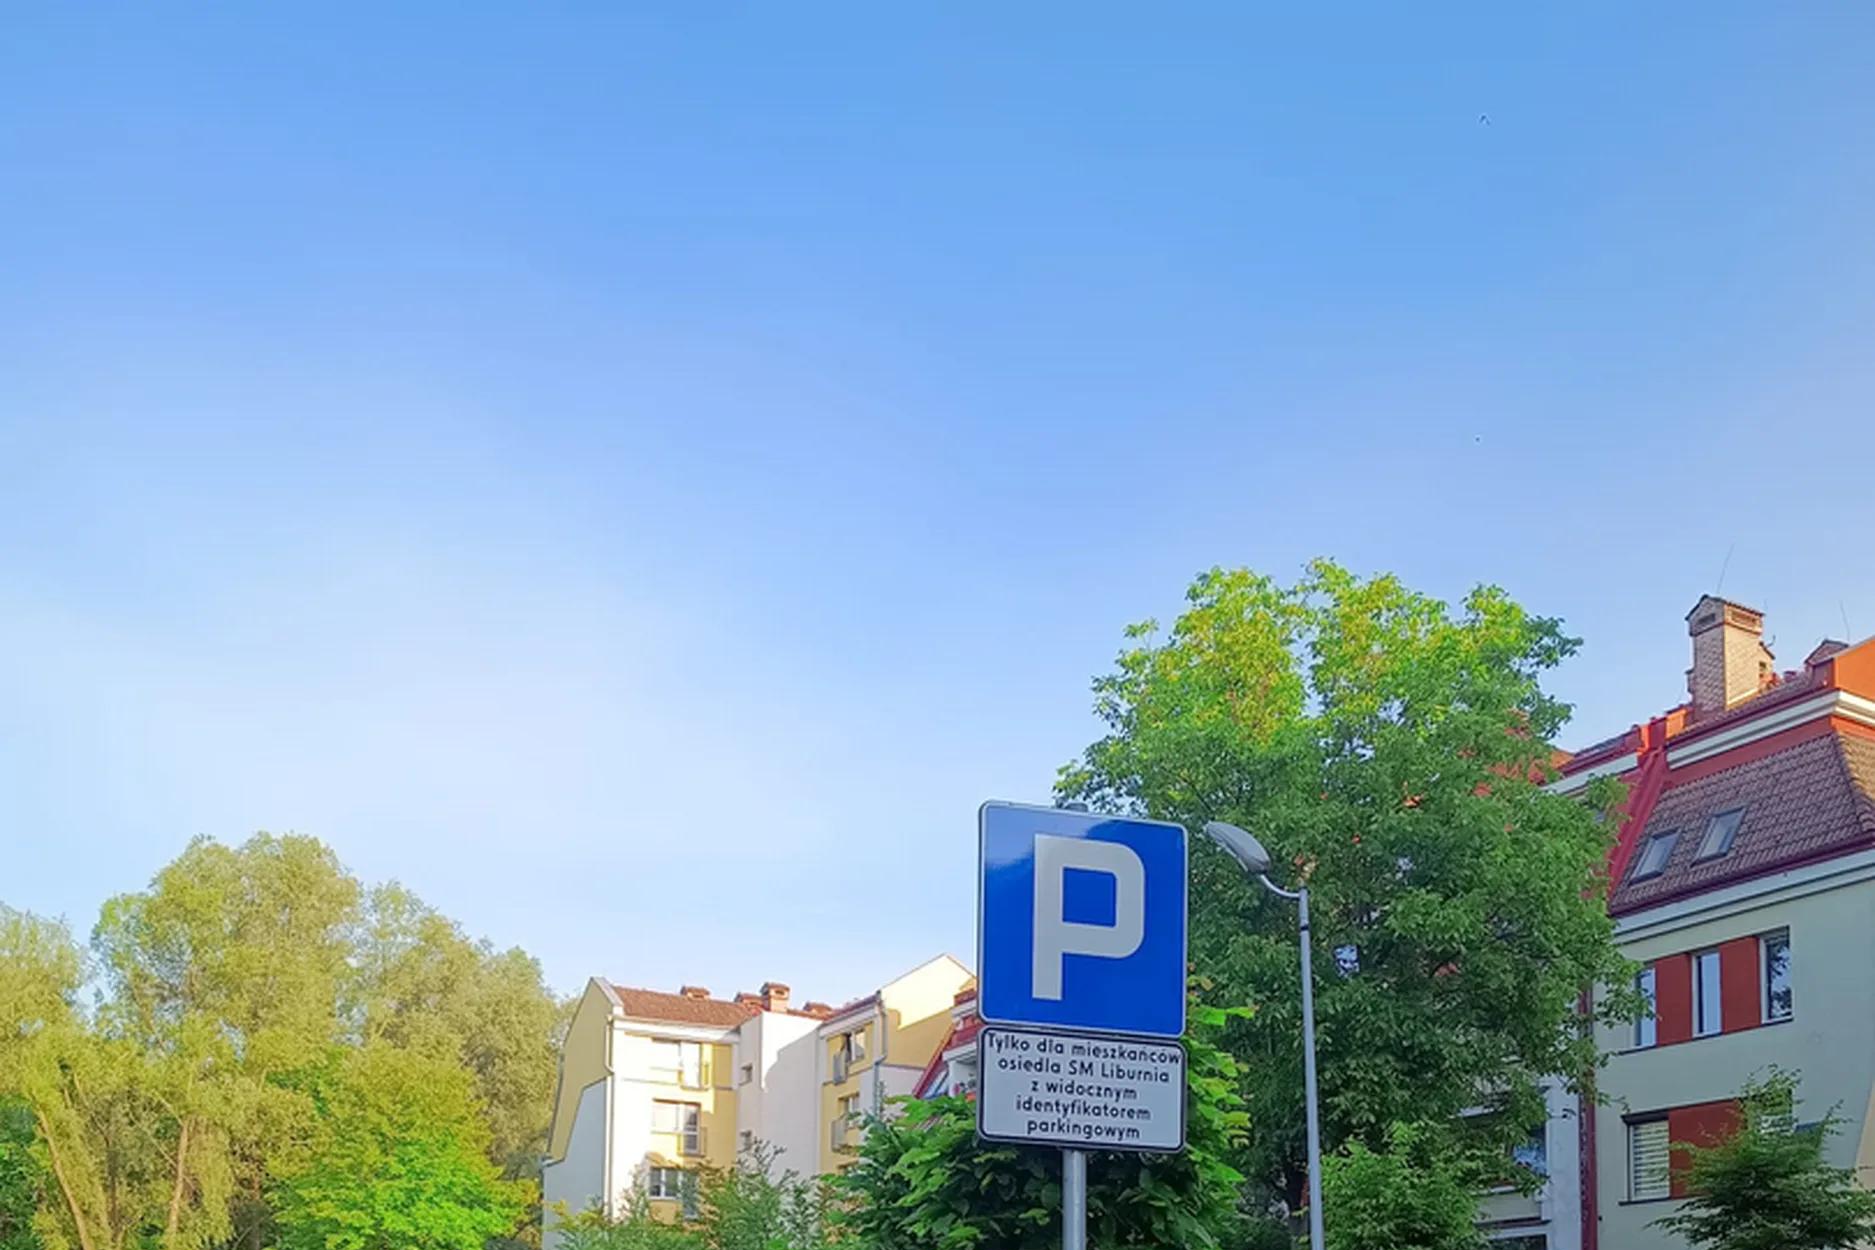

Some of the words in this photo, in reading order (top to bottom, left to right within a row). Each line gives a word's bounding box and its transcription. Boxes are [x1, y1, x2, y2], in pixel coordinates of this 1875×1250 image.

[1032, 833, 1146, 1001] P
[988, 1032, 1030, 1054] Tylko
[1037, 1039, 1064, 1054] dla
[1071, 1041, 1180, 1065] mieszkańców
[998, 1055, 1061, 1074] osiedla
[1068, 1060, 1093, 1076] SM
[1101, 1063, 1170, 1082] Liburnia
[1031, 1080, 1039, 1091] z
[1046, 1079, 1137, 1102] widocznym
[1016, 1095, 1151, 1120] identyfikatorem
[1027, 1118, 1140, 1141] parkingowym
